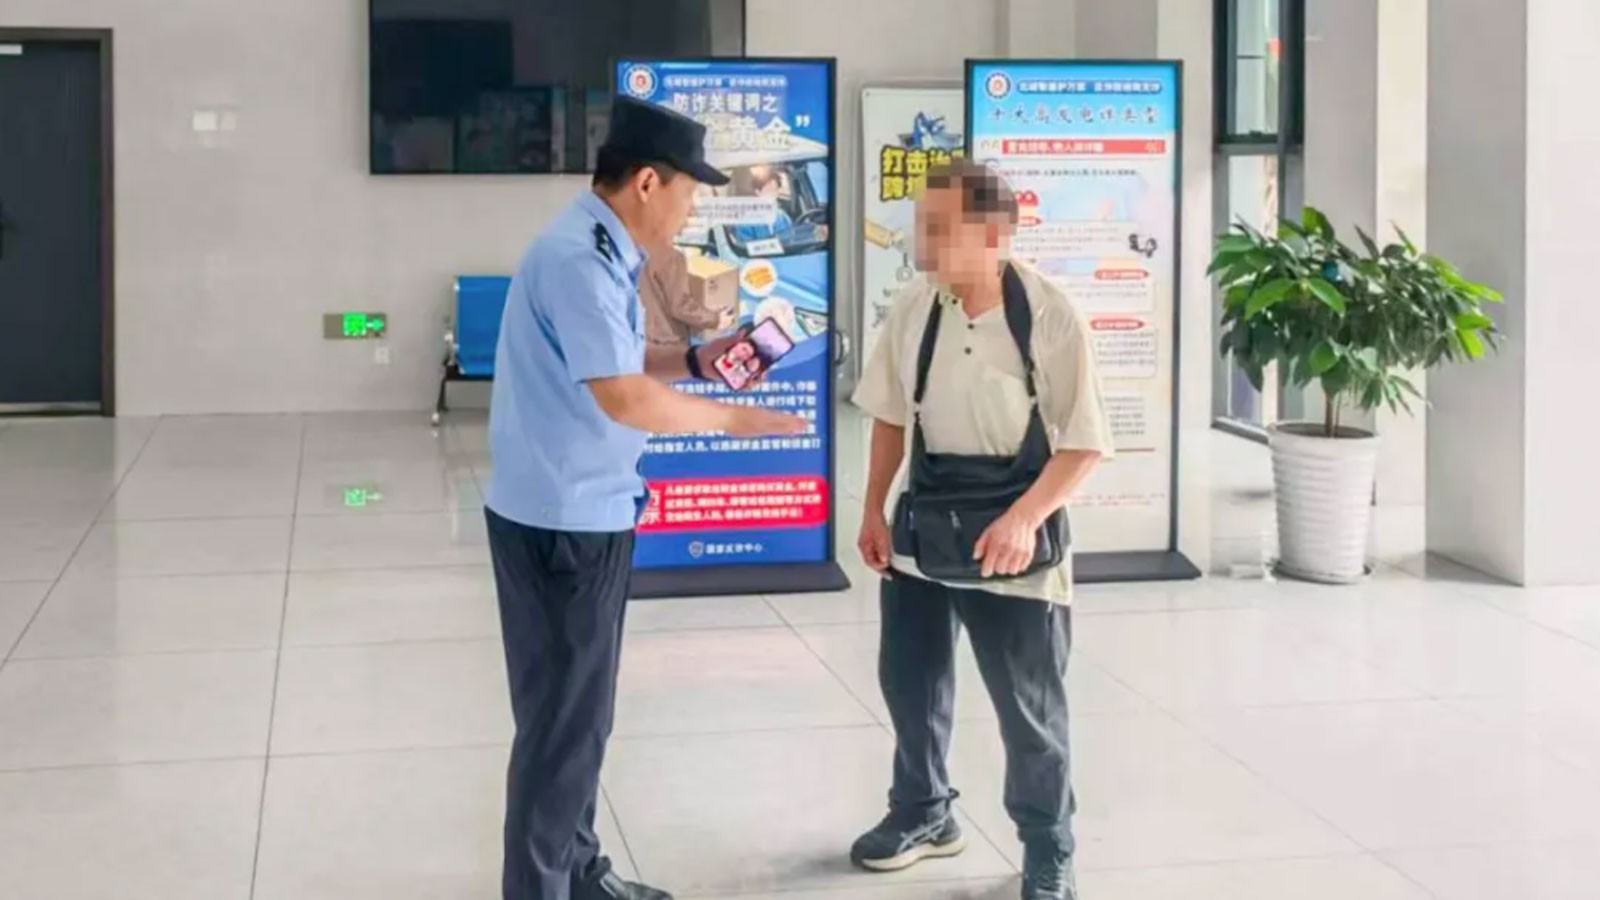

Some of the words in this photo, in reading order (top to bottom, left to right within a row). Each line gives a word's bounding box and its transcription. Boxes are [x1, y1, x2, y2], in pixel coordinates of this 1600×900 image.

[673, 92, 778, 112] 防诈关键词之
